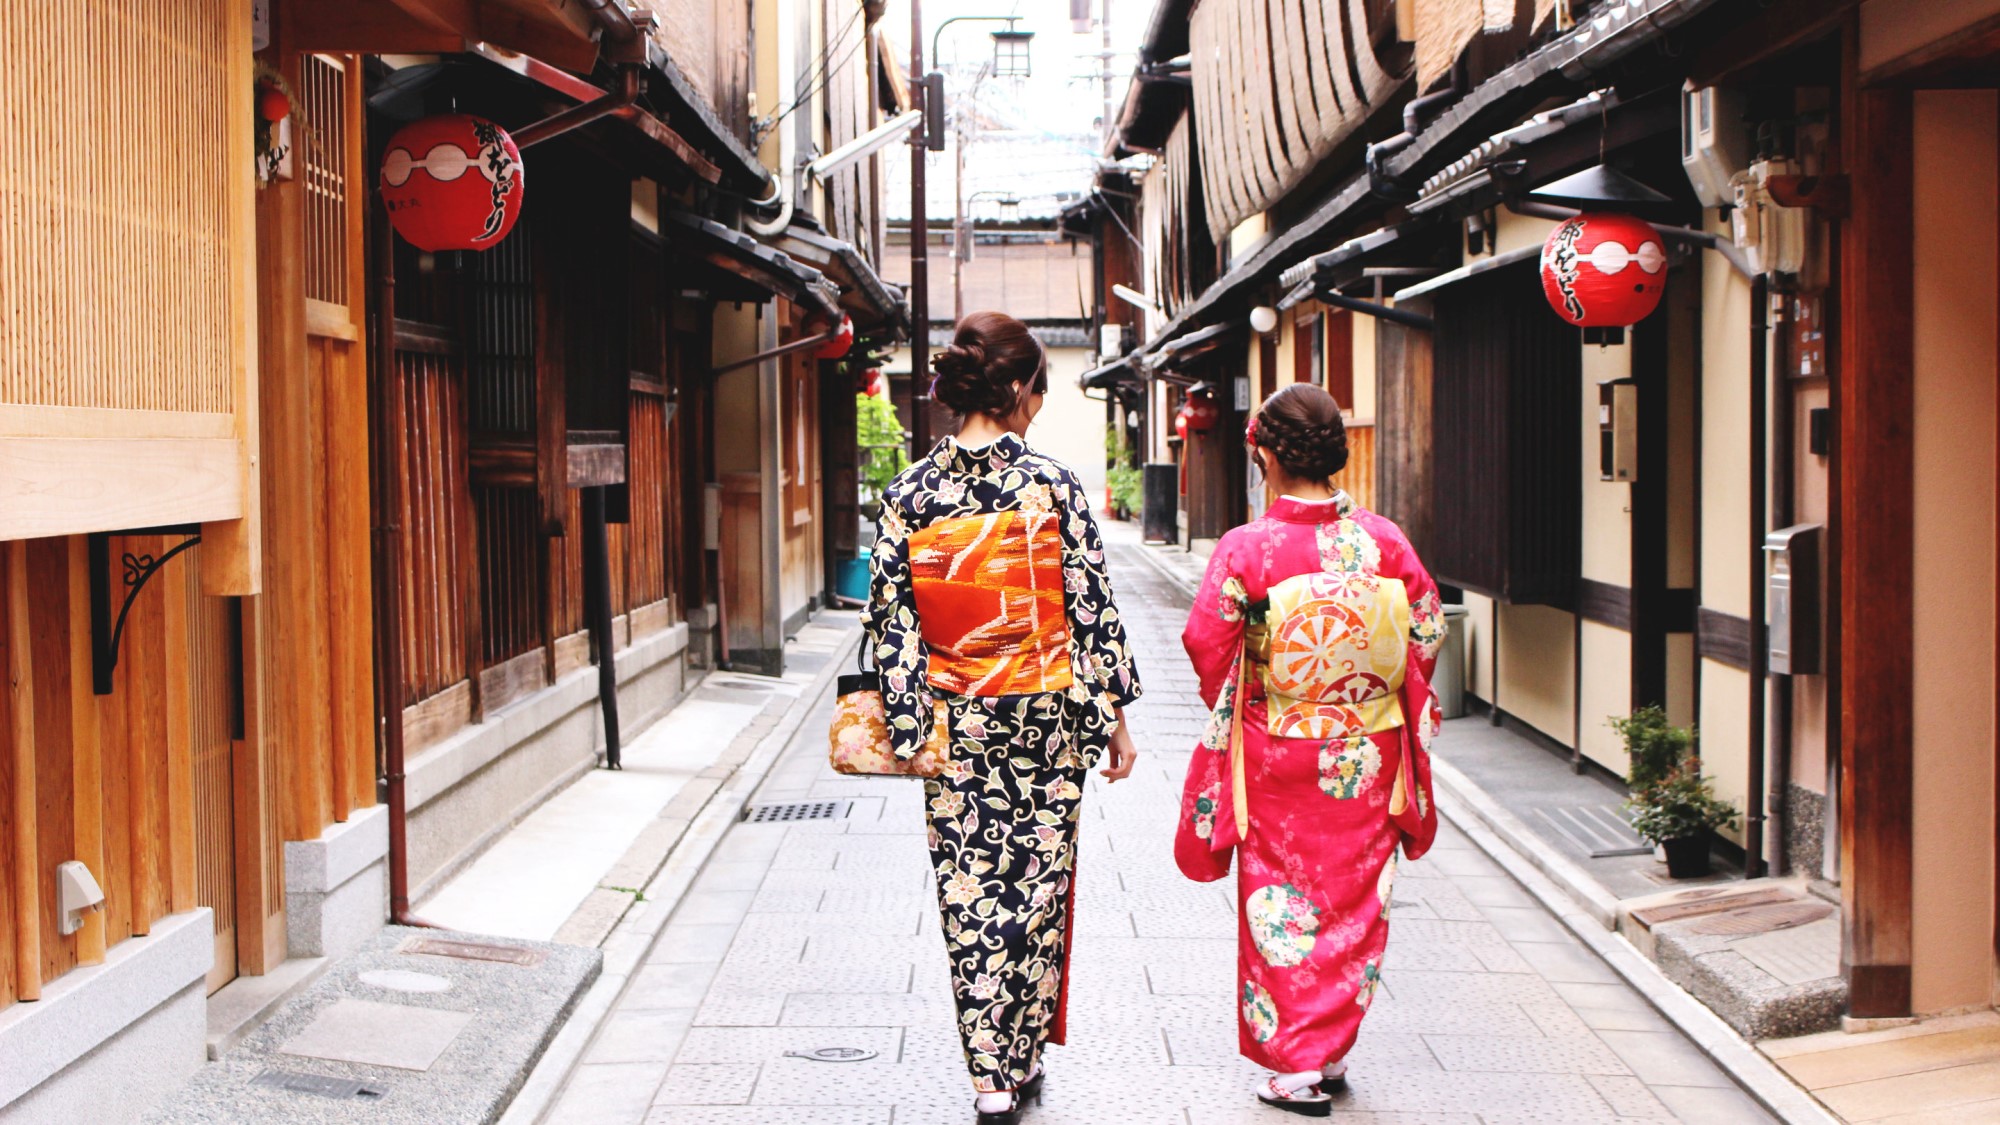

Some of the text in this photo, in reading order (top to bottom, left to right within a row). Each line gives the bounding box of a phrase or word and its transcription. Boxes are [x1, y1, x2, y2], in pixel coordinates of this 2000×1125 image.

[471, 118, 514, 242] 都をどり
[1552, 220, 1587, 321] 都をどり
